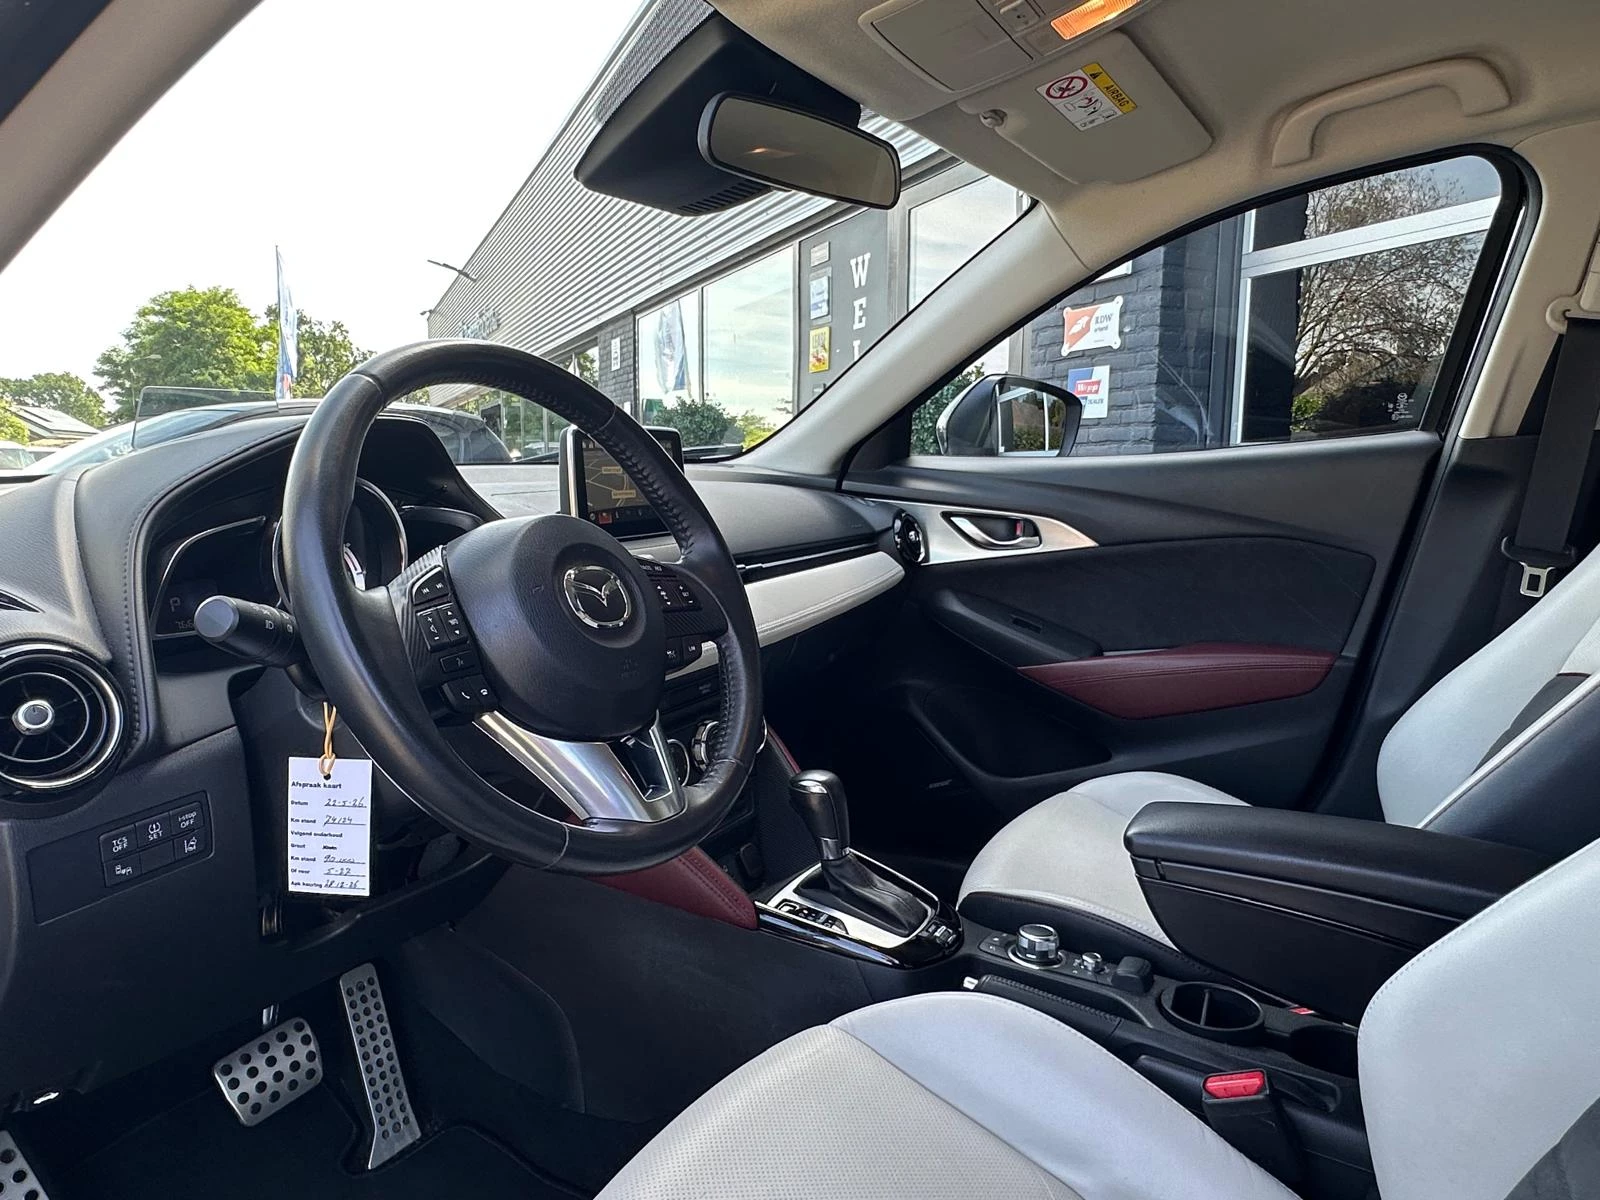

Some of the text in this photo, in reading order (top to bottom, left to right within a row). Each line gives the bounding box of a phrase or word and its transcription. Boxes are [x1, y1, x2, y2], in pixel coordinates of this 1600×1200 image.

[1104, 84, 1130, 107] AIRBAG
[1095, 313, 1114, 325] RDW
[169, 596, 181, 612] P
[291, 781, 321, 789] Afspraak
[180, 819, 195, 829] OFF
[148, 831, 163, 841] SET
[112, 836, 128, 847] TCS
[112, 843, 128, 853] OFF
